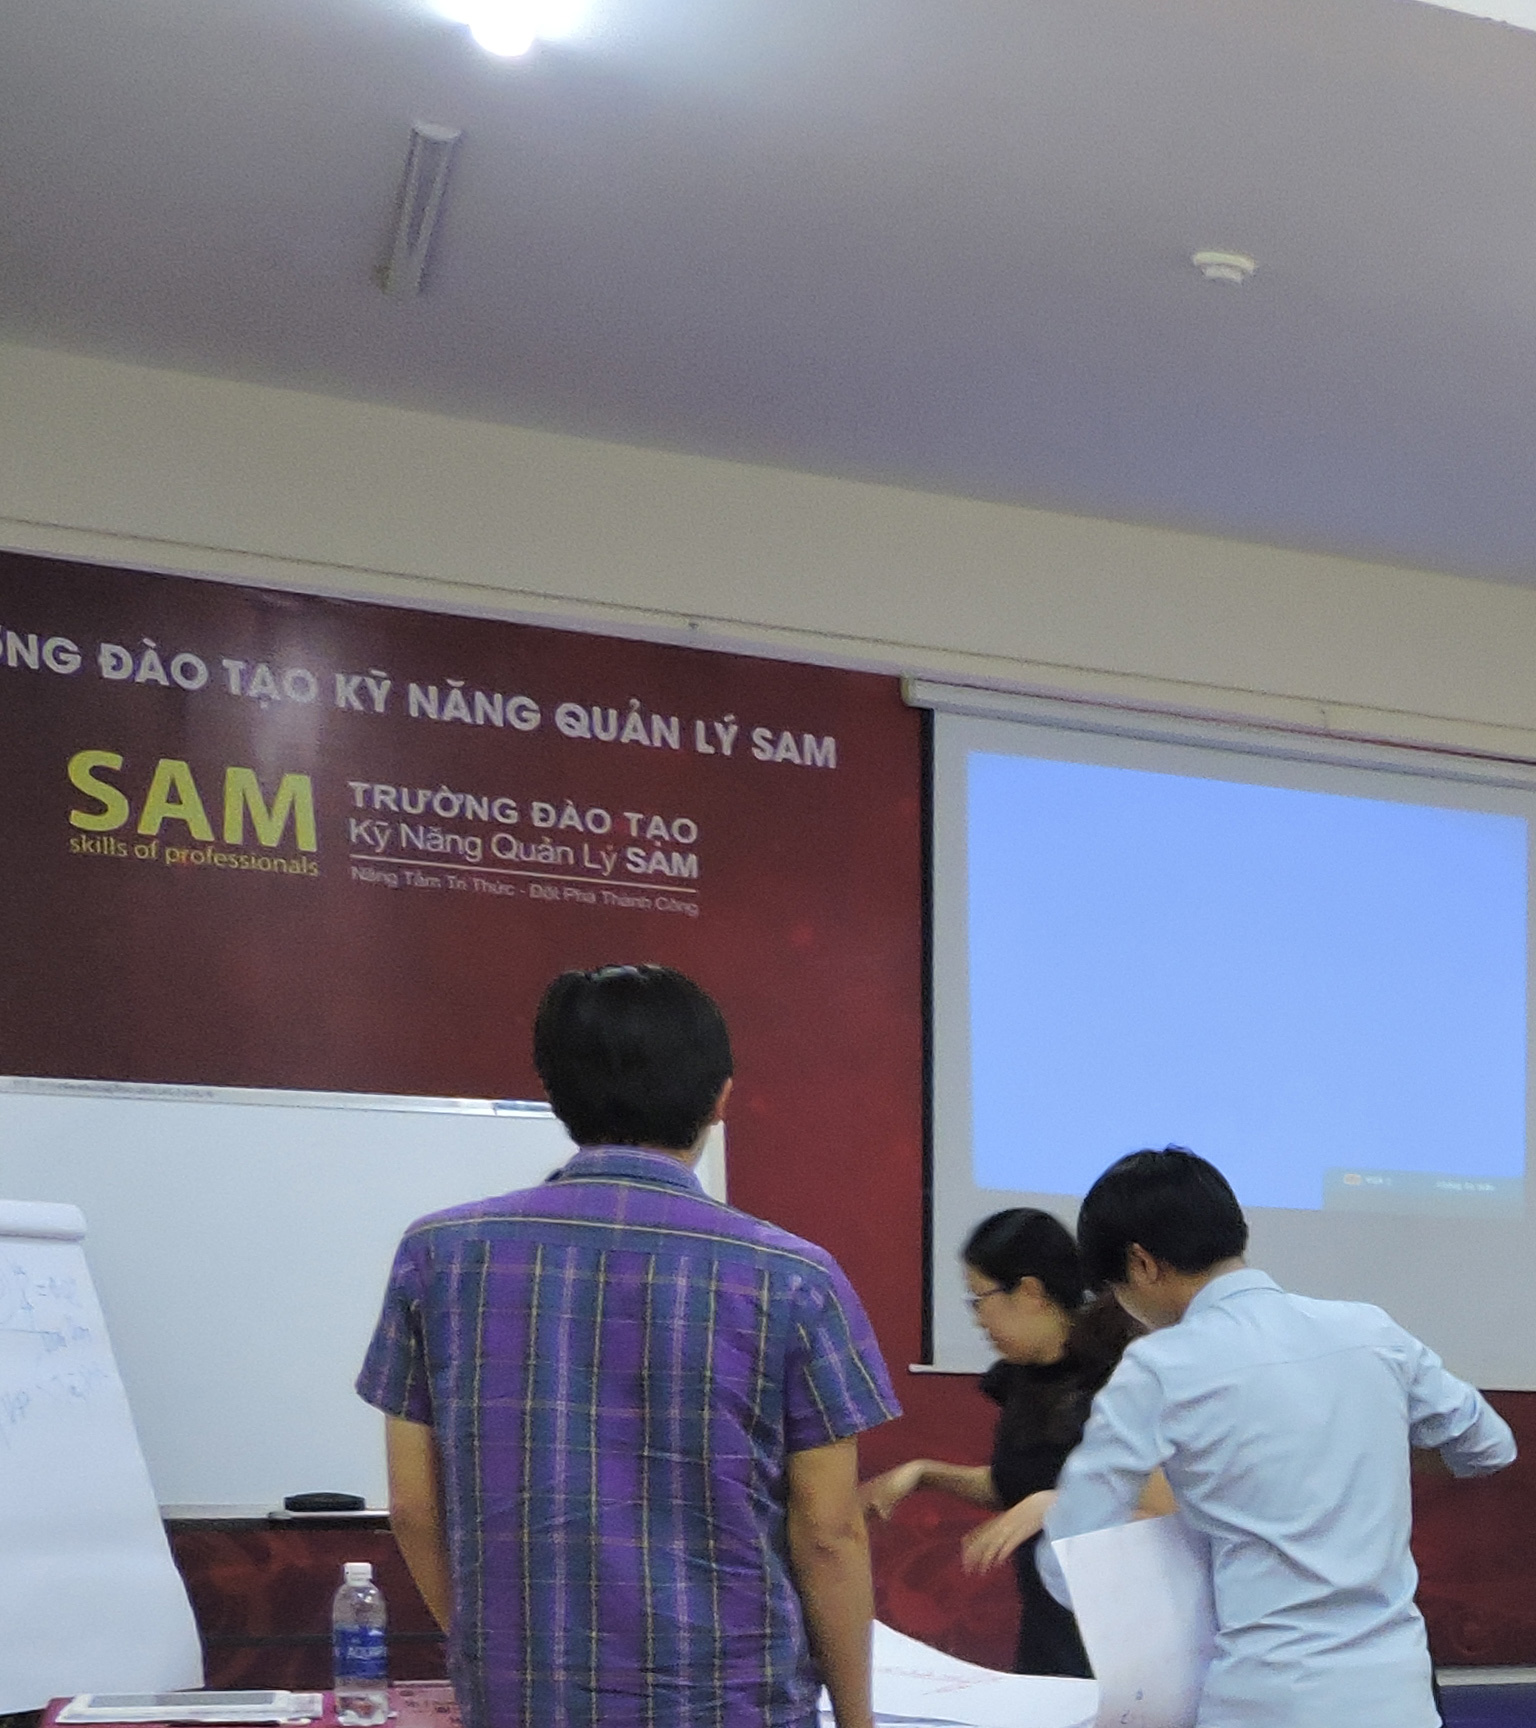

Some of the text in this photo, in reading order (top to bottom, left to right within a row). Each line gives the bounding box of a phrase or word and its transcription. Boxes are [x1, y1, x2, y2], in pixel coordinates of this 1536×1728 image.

[0, 624, 838, 769] NG ĐÀO TẠO KỸ NĂNG QUẢN LÝ SAM
[67, 750, 318, 852] SAM
[347, 780, 698, 848] TRƯỜNG ĐÀO TẠO
[69, 834, 319, 877] skills of professionals
[348, 817, 391, 853] Kỹ
[398, 823, 483, 863] Năng
[491, 832, 575, 866] Quản
[626, 845, 699, 880] SAM
